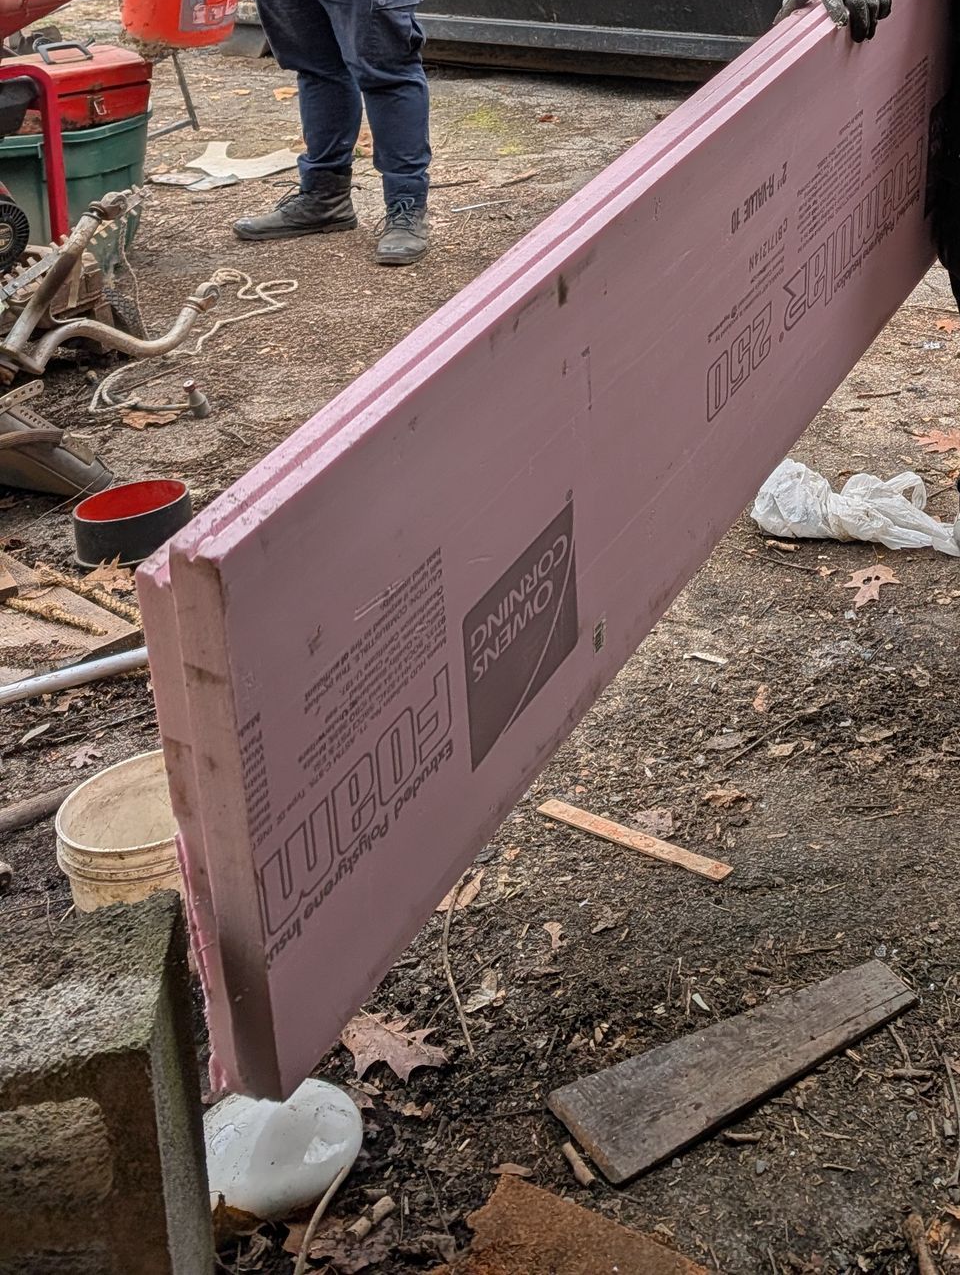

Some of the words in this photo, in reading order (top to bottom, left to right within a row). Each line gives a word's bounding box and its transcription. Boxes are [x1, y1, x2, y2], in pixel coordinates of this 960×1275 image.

[730, 205, 741, 236] 10
[742, 172, 775, 223] R-VALUE
[705, 299, 773, 423] 250
[471, 534, 568, 656] CORNING
[473, 579, 555, 684] OWENS
[393, 736, 454, 821] Extruded
[301, 813, 389, 926] Polystyrene
